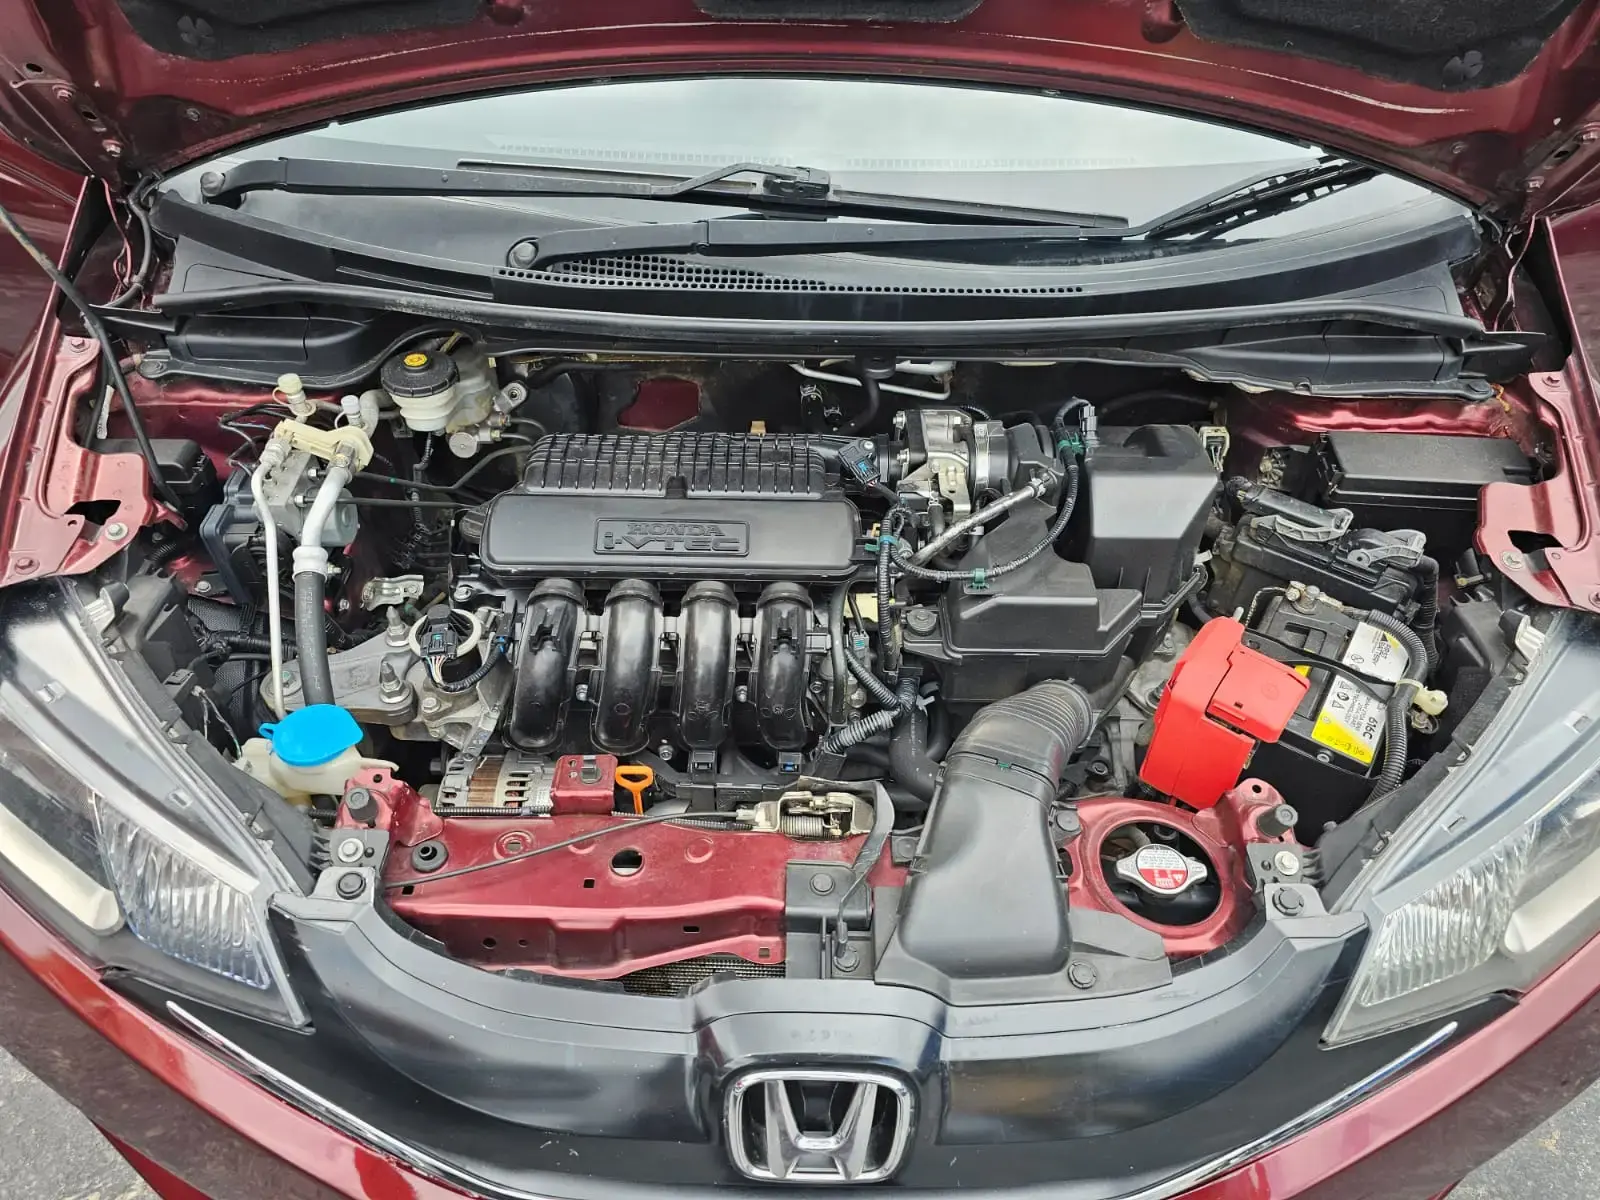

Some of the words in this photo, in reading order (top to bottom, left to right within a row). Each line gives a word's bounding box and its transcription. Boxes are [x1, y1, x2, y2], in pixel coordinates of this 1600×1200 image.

[626, 523, 726, 537] HONDA
[603, 531, 741, 551] i-VTEC
[1361, 715, 1379, 740] 616C
